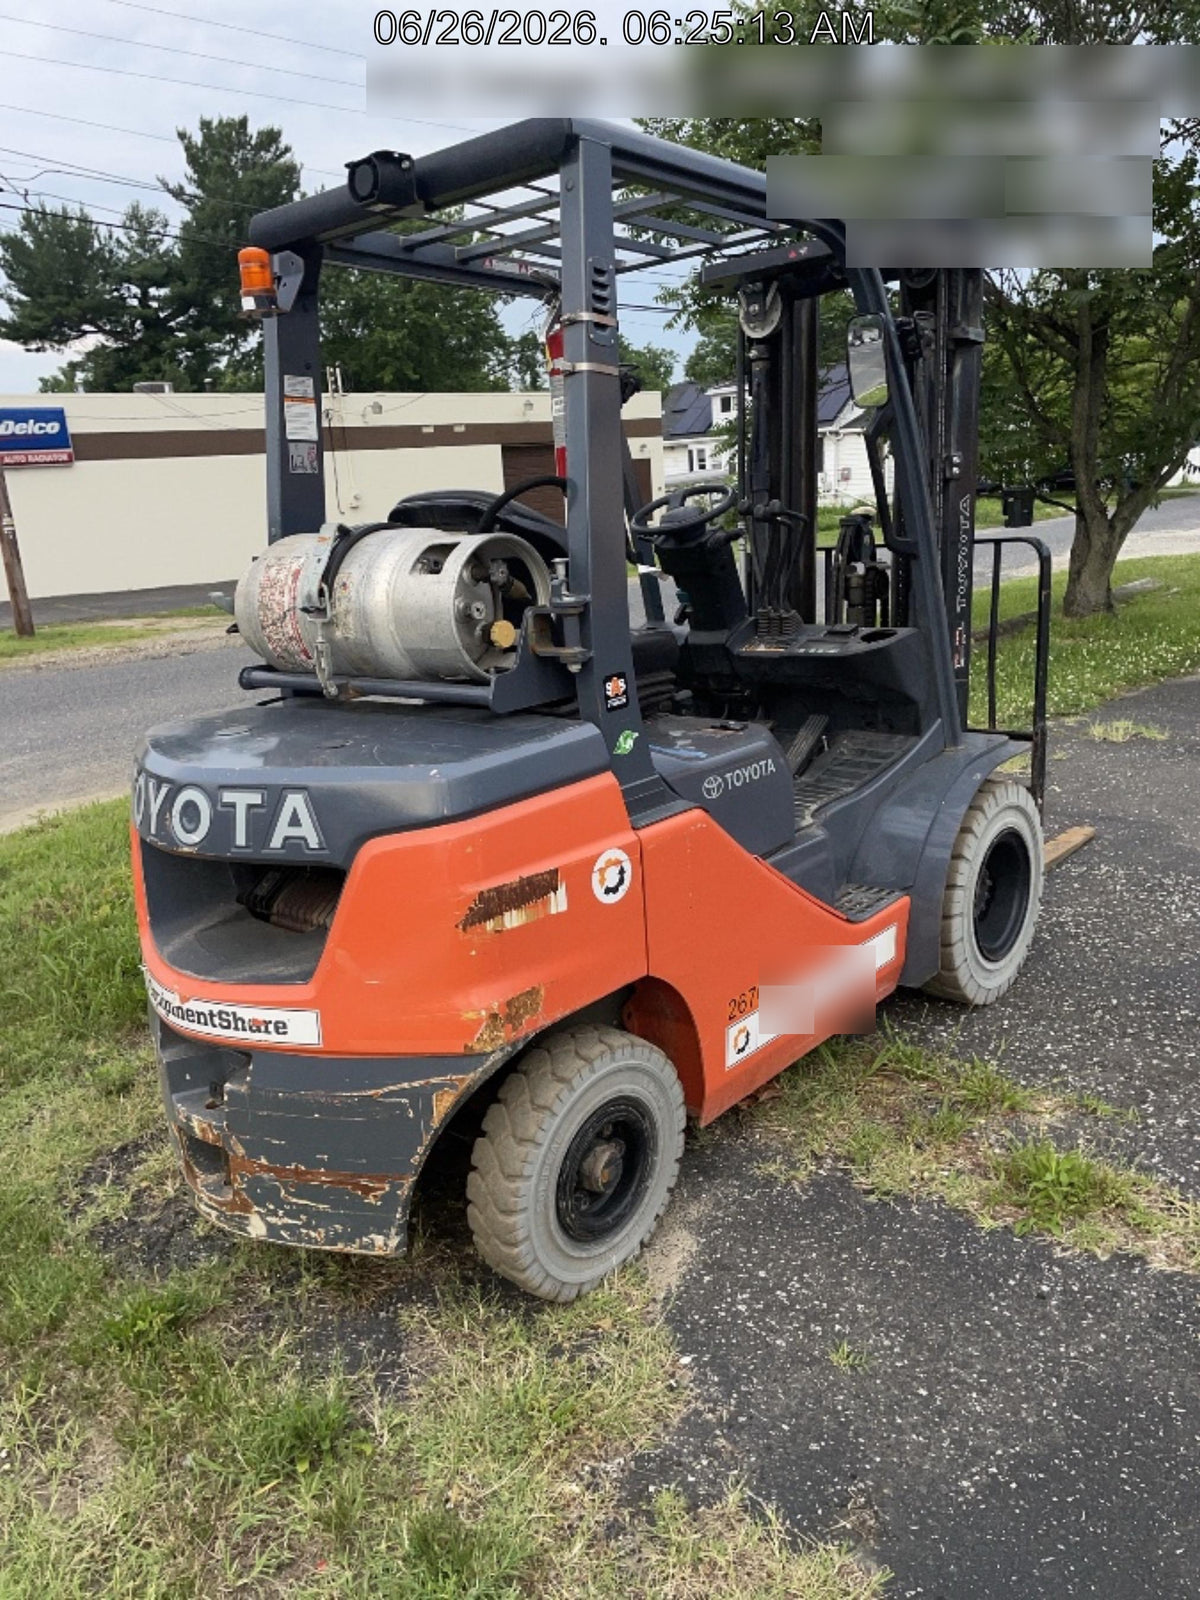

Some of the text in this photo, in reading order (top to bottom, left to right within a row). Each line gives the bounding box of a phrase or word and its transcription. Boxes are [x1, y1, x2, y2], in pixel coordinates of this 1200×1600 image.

[0, 419, 60, 435] Delco
[724, 758, 776, 790] TOYOTA
[134, 772, 325, 852] OYOTA
[728, 986, 759, 1020] 267
